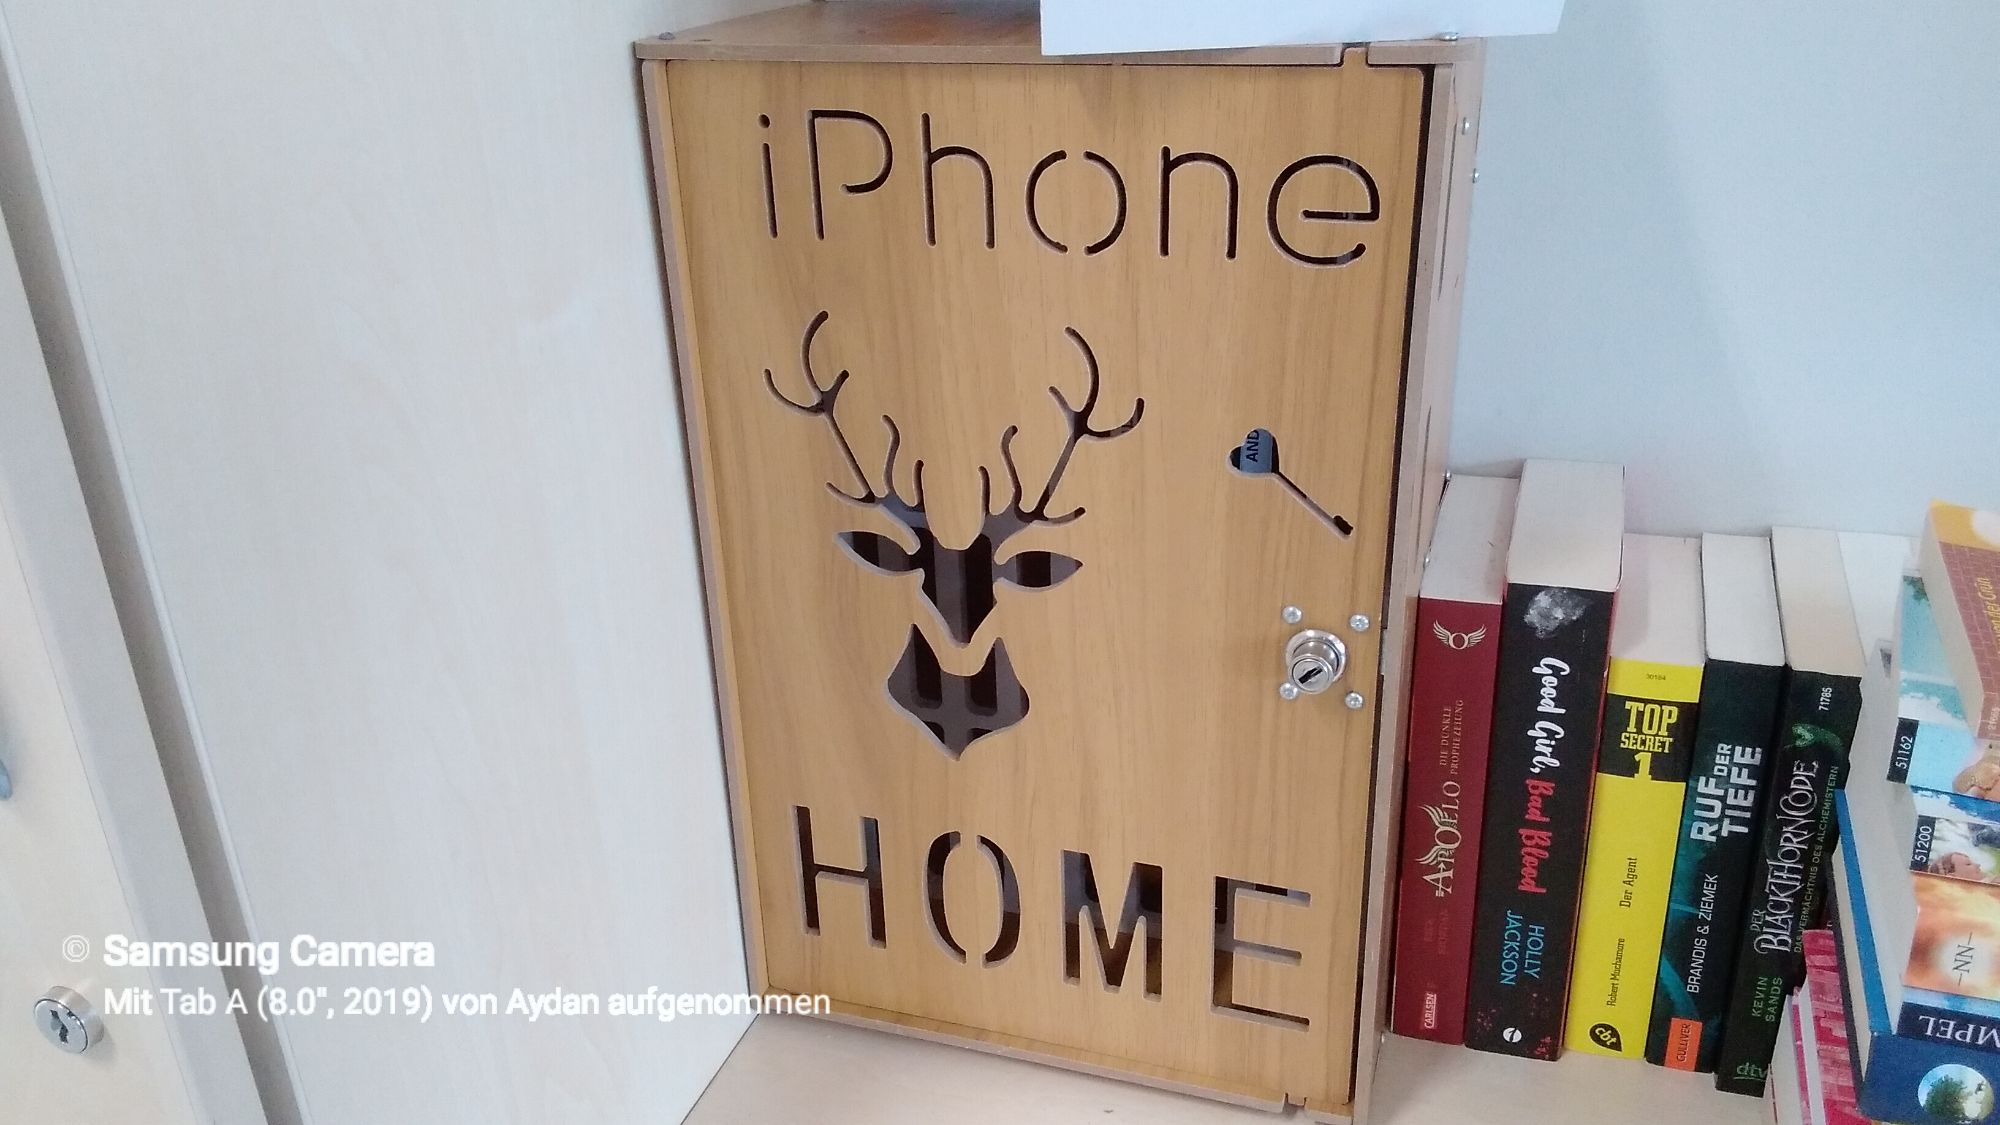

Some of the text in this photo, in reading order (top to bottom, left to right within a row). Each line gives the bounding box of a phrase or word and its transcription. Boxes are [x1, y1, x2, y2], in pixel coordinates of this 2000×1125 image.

[758, 108, 1382, 268] iPhone
[1624, 700, 1679, 736] TOP
[1818, 687, 1833, 711] 71785
[1439, 706, 1452, 766] DIE DUNKLE
[1450, 699, 1464, 775] PROPHEZEIUNG
[1620, 733, 1673, 753] SECRET
[1895, 735, 1914, 769] 51162
[1518, 656, 1570, 893] Good Girl, Bad Blood
[1633, 752, 1652, 780] 1
[1721, 745, 1762, 837] TIEFE
[1690, 743, 1733, 843] RUF DER
[1817, 765, 1839, 842] ALCHEMISTERN
[1417, 781, 1462, 897] APOLLO
[1812, 844, 1823, 863] DES
[1914, 825, 1932, 863] 51200
[1619, 857, 1638, 908] Der Agent
[793, 805, 1312, 1032] HOME
[1687, 873, 1719, 993] BRANDIS & ZIEMEK
[1751, 909, 1767, 932] DER
[1500, 910, 1523, 985] JACKSON
[1524, 925, 1545, 979] HOLLY
[1606, 938, 1625, 1006] Robert Muchamore
[1424, 992, 1437, 1029] CARLSEN
[1752, 976, 1768, 1017] KEVIN
[1765, 977, 1783, 1022] SANDS
[1595, 1027, 1617, 1046] cbt
[1676, 1023, 1692, 1062] GULLIVER
